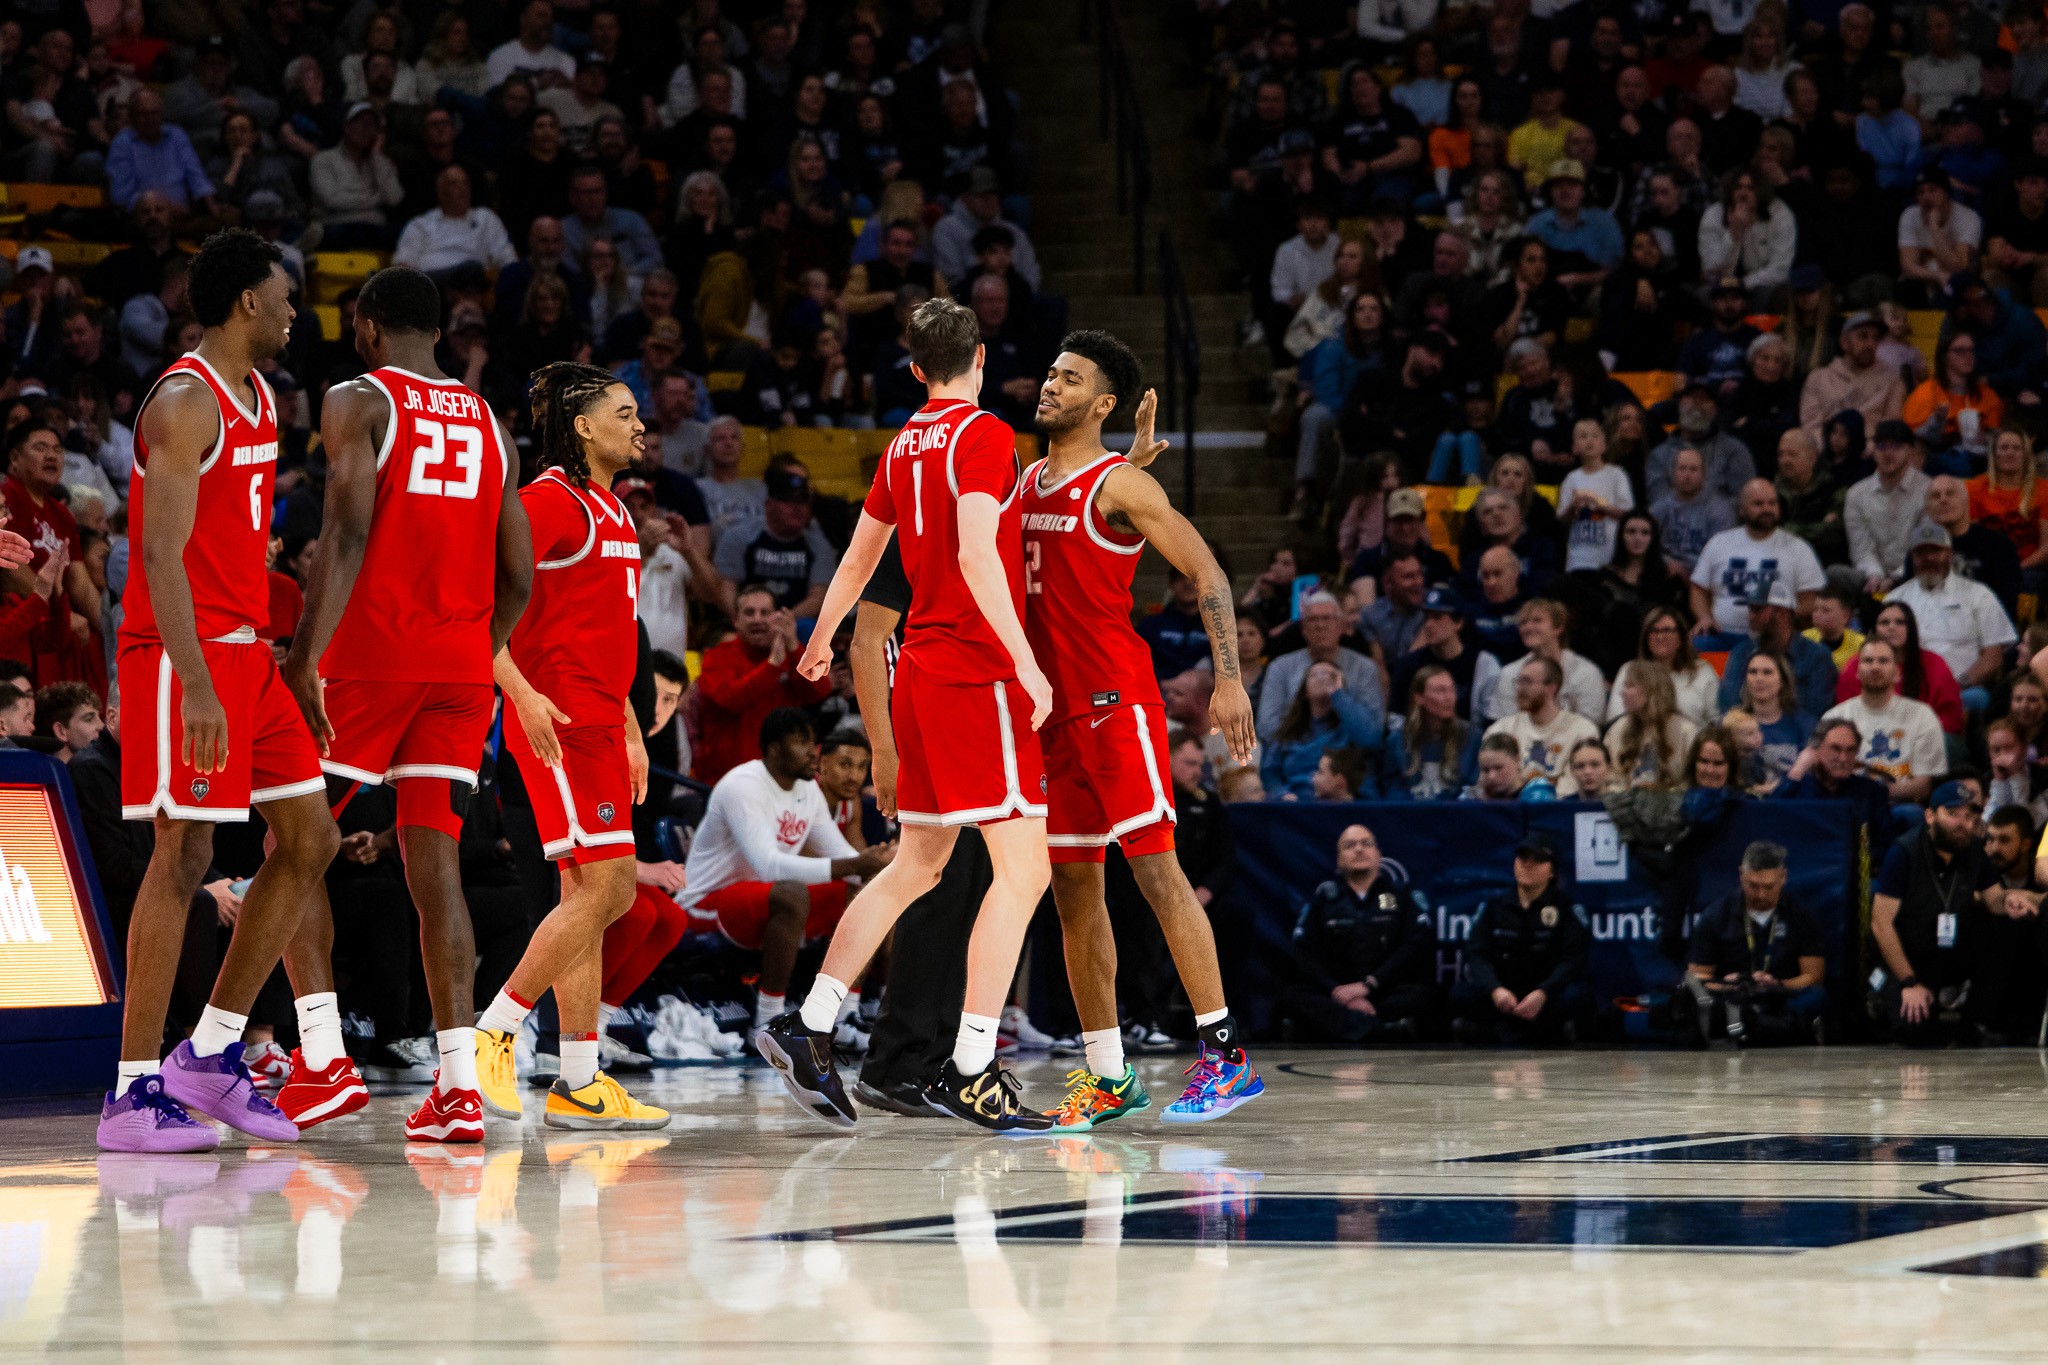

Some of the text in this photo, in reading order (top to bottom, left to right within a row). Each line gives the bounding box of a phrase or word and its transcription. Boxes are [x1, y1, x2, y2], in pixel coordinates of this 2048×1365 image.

[403, 385, 482, 421] JR JOSEPH
[232, 445, 252, 466] NEW
[406, 417, 484, 500] 23
[249, 473, 264, 531] 6
[912, 460, 923, 537] 1
[1027, 512, 1079, 533] MEXICO
[601, 540, 622, 558] NEW
[626, 566, 638, 621] 4
[1213, 612, 1225, 639] GOD
